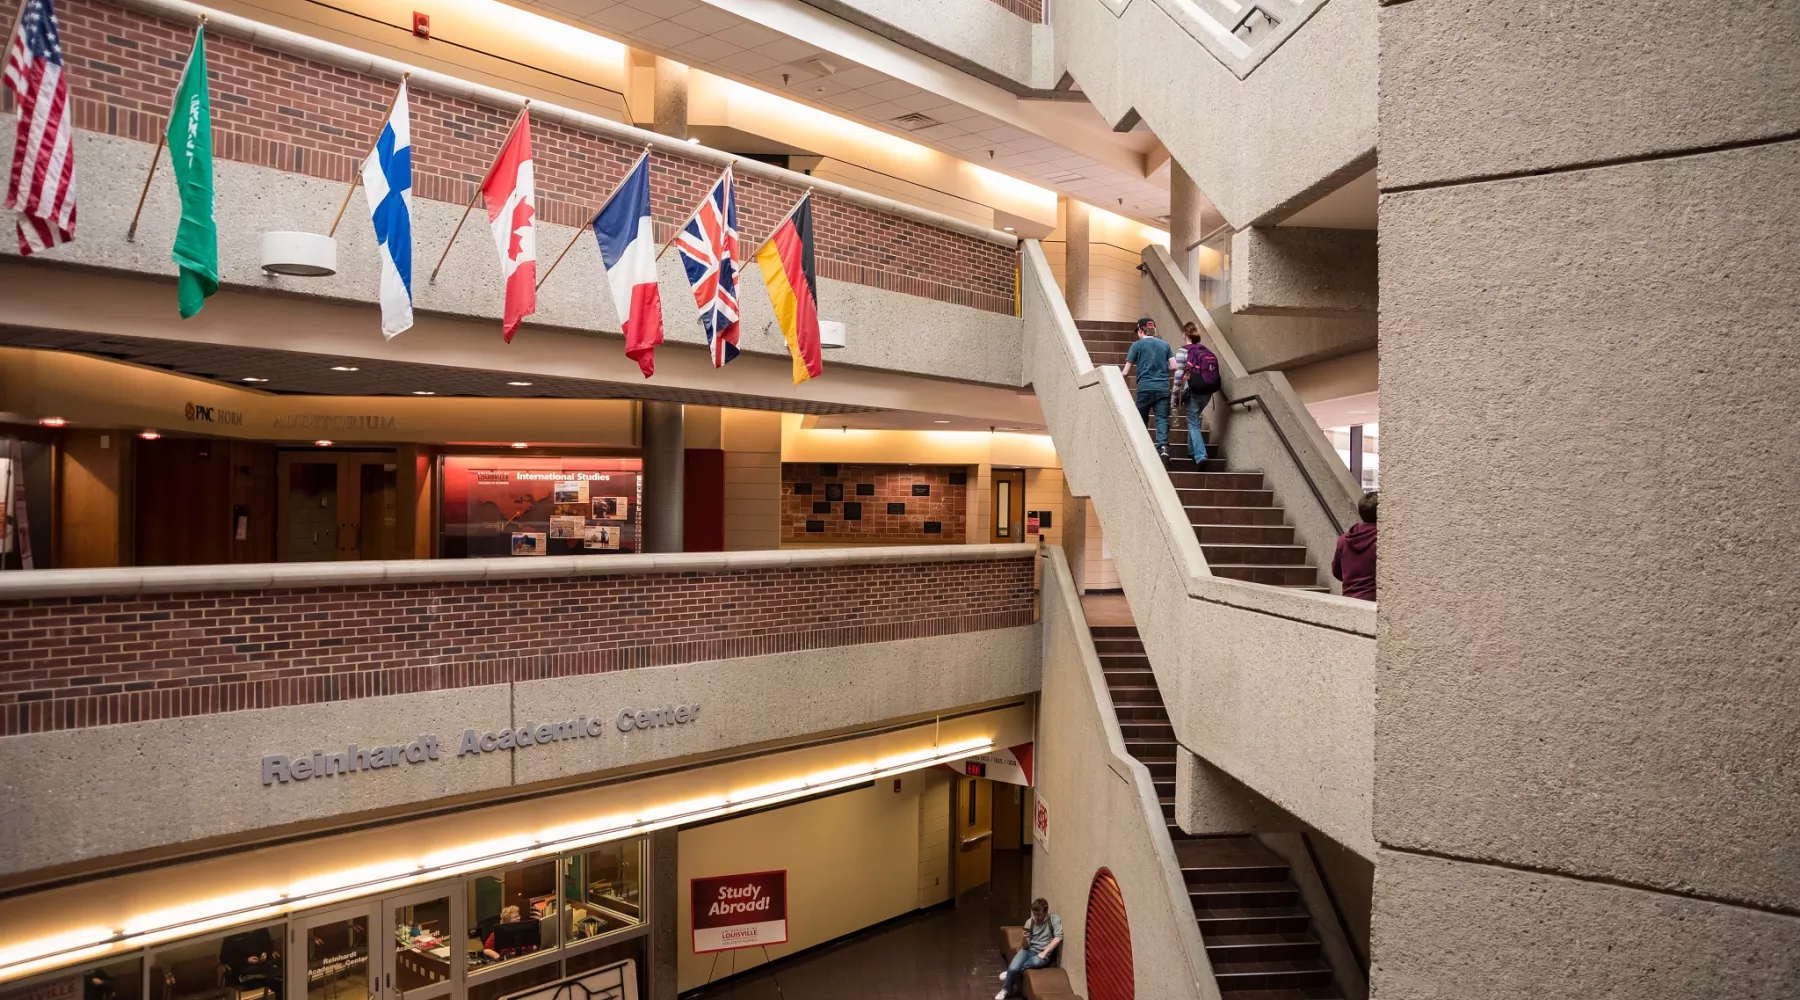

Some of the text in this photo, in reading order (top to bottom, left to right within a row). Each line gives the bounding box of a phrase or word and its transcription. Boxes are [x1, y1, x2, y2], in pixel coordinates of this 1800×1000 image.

[195, 405, 242, 426] PNC HORN
[273, 415, 396, 430] AUDITORIUM
[516, 472, 610, 481] International Studies
[263, 703, 700, 785] Reinhardt Academic Center
[718, 884, 761, 900] Study
[708, 896, 770, 916] Abroad!
[722, 929, 757, 939] LOUISVILLE
[308, 955, 368, 976] Academic Center
[323, 951, 357, 965] Reinhardt
